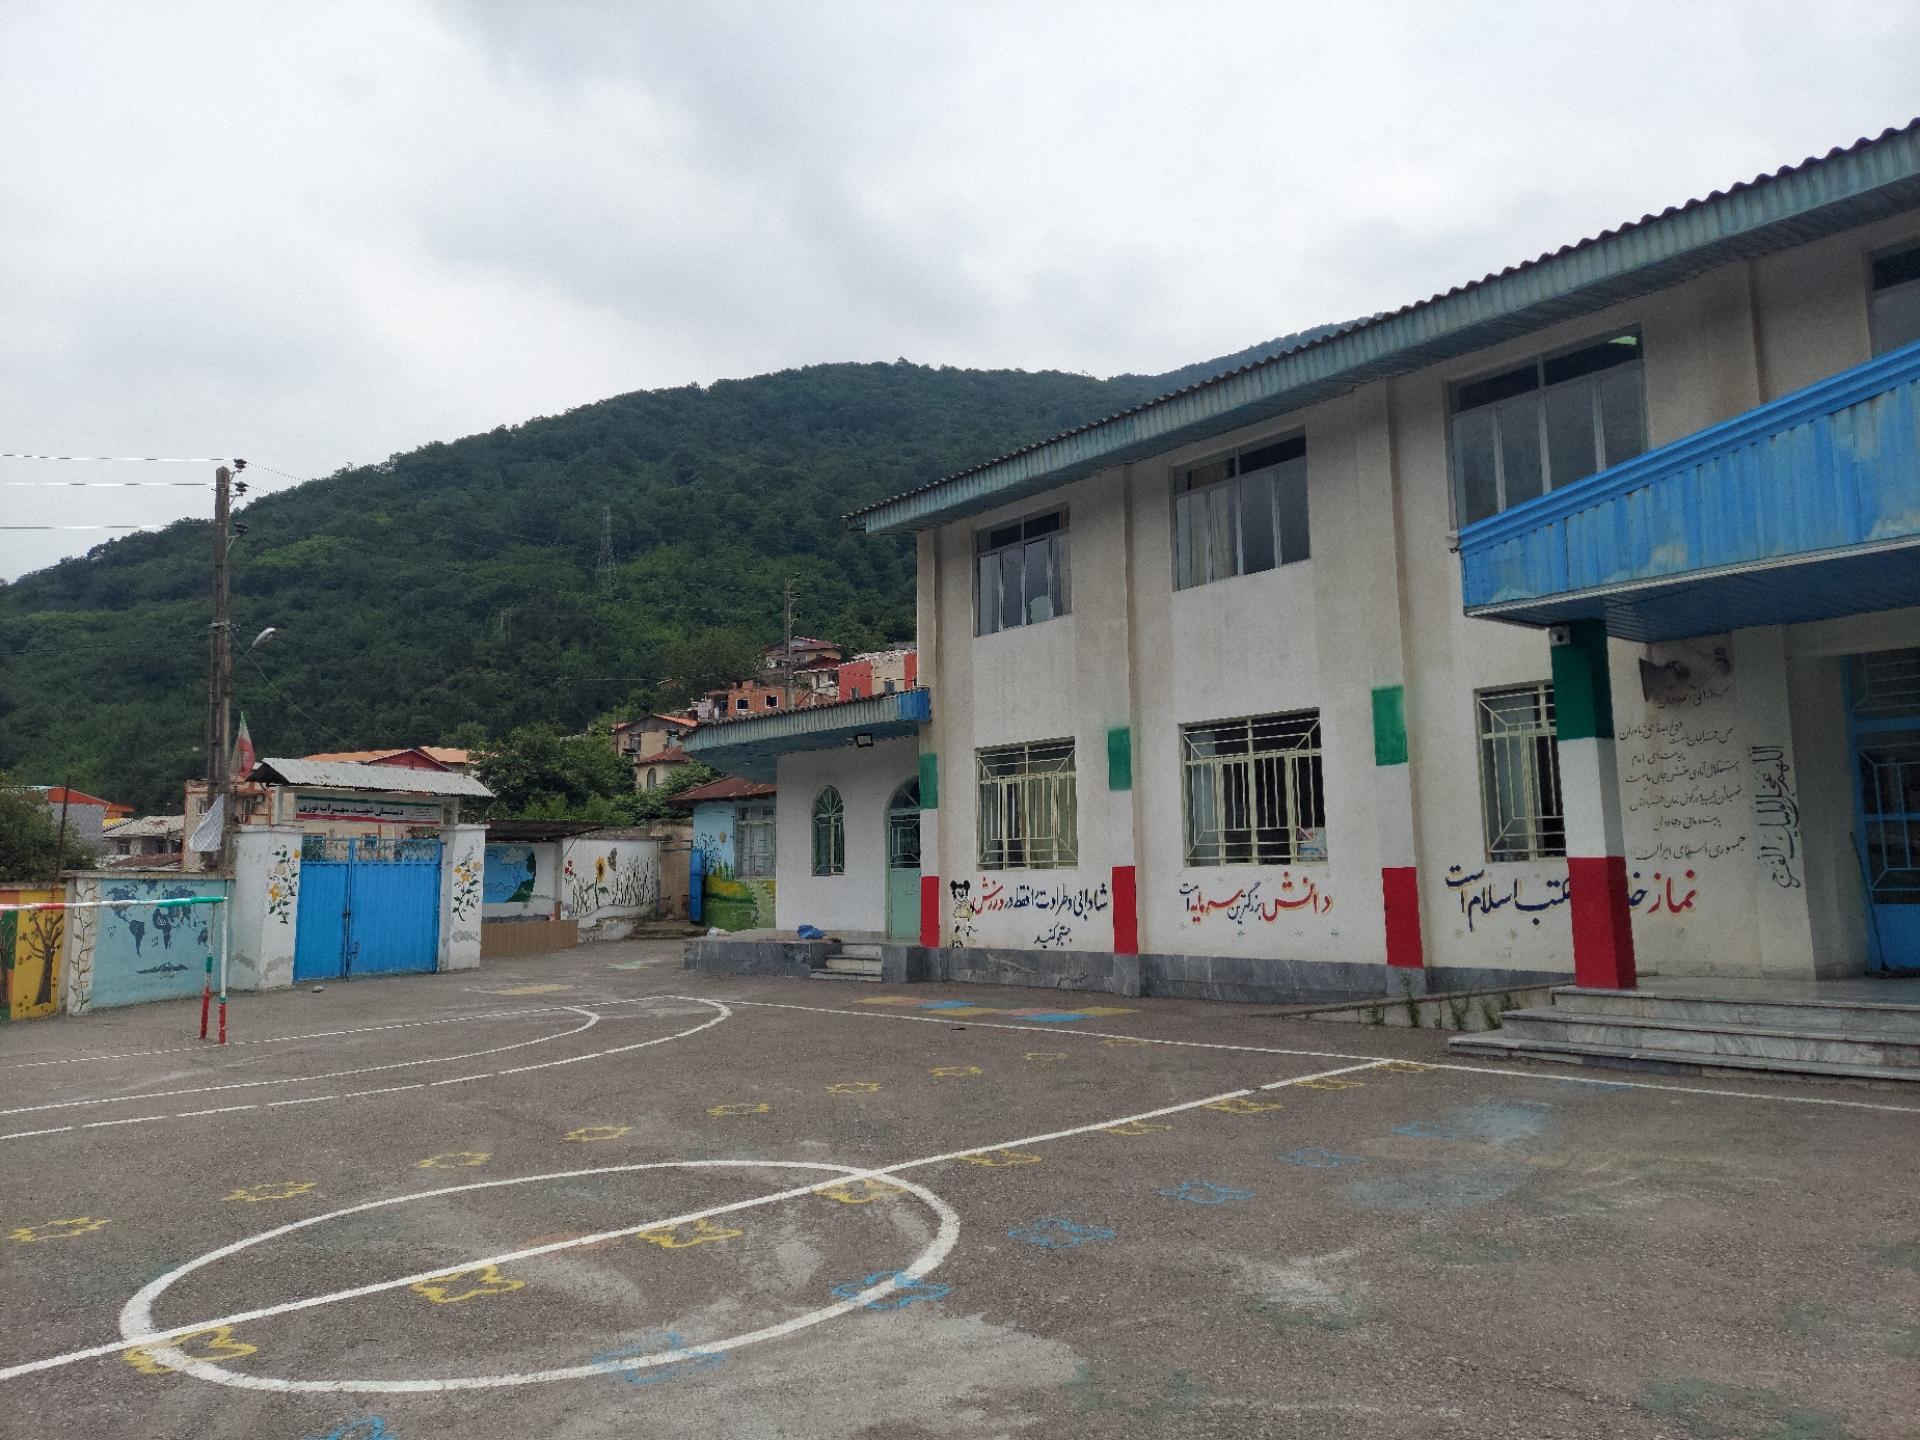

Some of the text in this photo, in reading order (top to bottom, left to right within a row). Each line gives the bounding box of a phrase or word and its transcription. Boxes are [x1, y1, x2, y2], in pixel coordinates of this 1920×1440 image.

[350, 806, 375, 816] شهید
[375, 808, 404, 817] دبستان
[1634, 842, 1673, 862] ایران
[1708, 836, 1747, 860] جمهوری
[971, 876, 1004, 916] ورزش
[1013, 884, 1030, 909] فقط
[1073, 882, 1108, 921] شادابی
[1178, 871, 1333, 925] دانش بزرگترین سرمایه است
[1445, 864, 1485, 914] است
[1647, 870, 1697, 915] نماز
